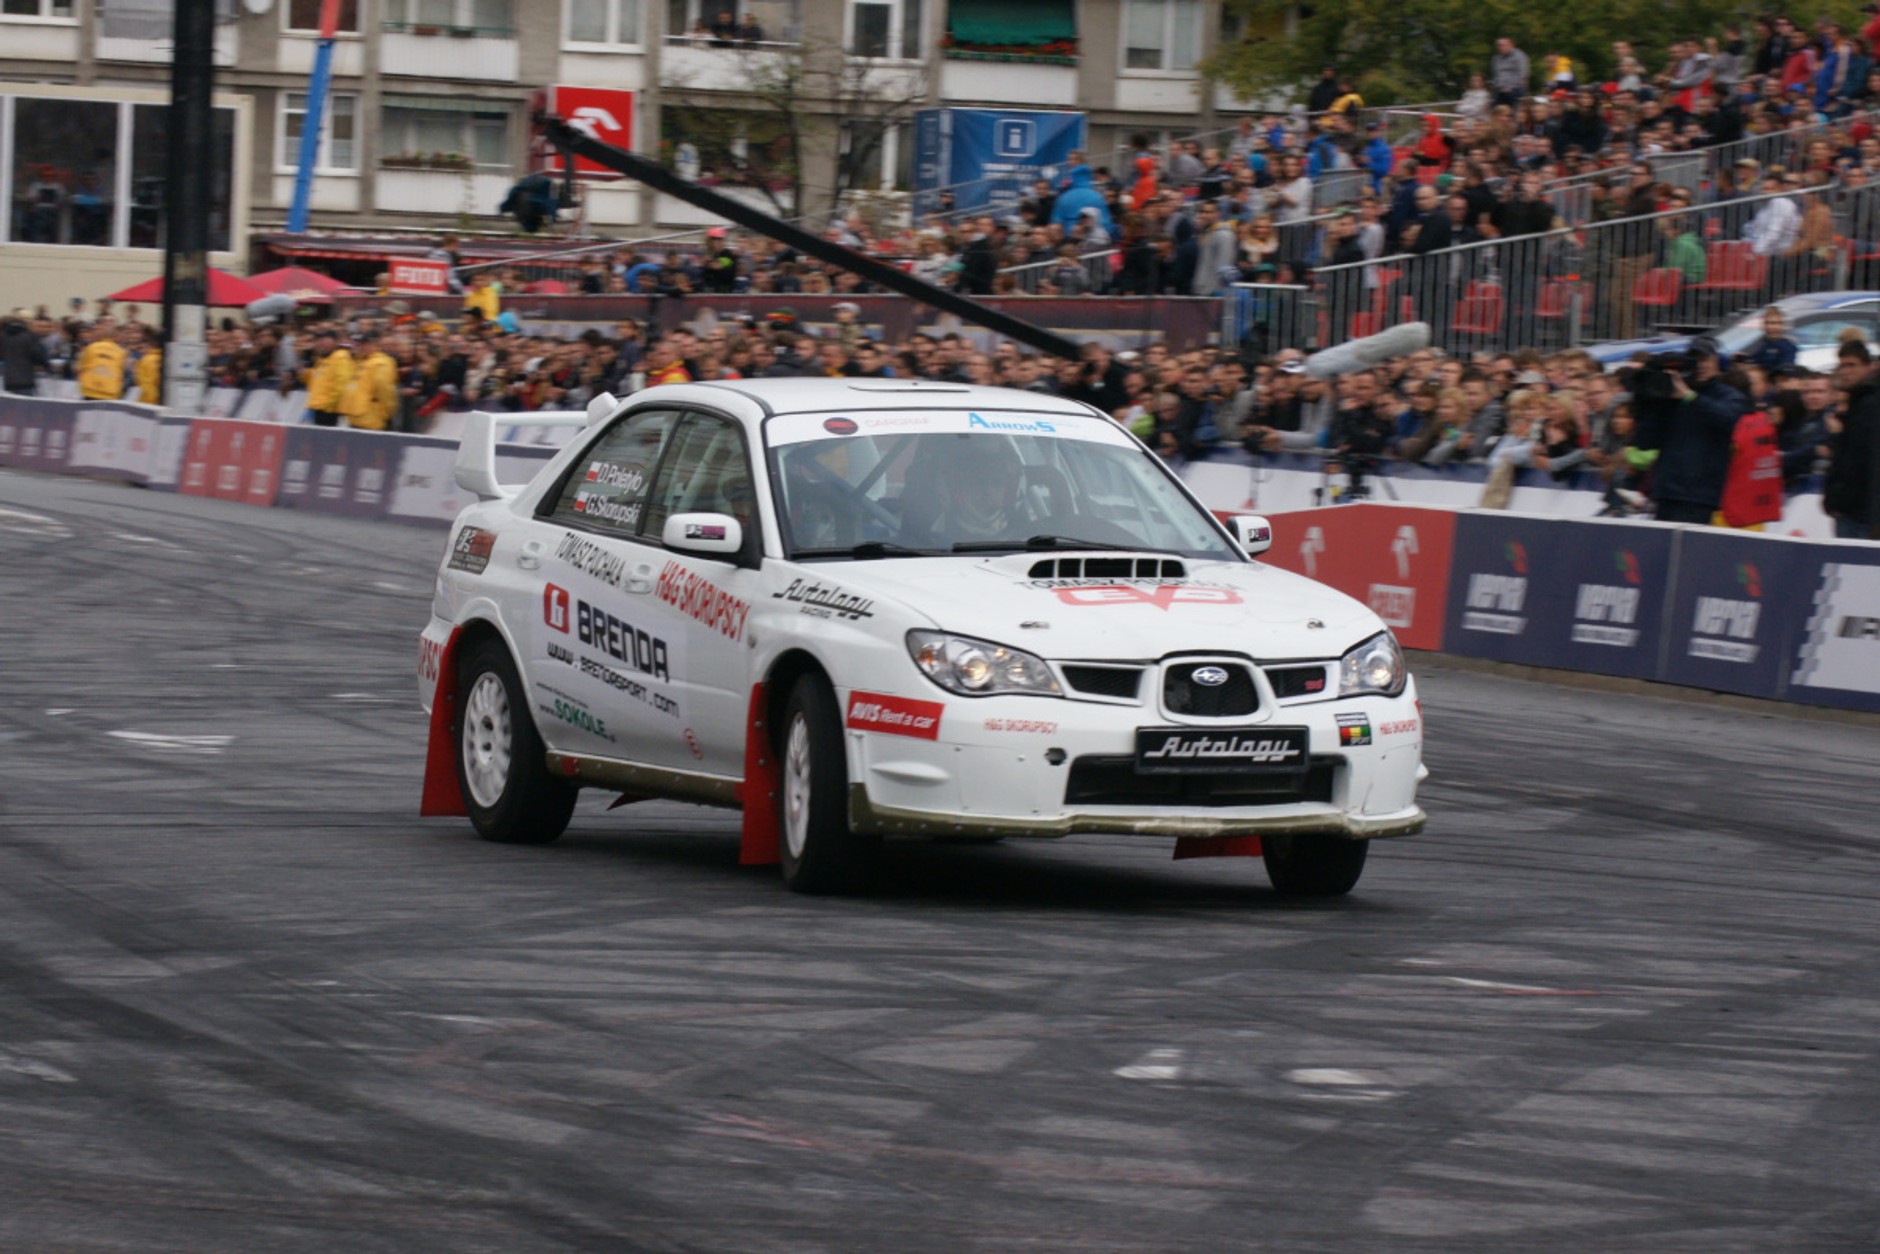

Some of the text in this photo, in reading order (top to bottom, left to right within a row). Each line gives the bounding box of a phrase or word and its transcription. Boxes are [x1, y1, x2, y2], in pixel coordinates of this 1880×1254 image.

[680, 571, 752, 643] SKORUPSCY
[577, 599, 669, 684] BRENDA
[850, 702, 881, 722] AVIS
[913, 716, 937, 729] car
[1144, 735, 1300, 763] Autology
